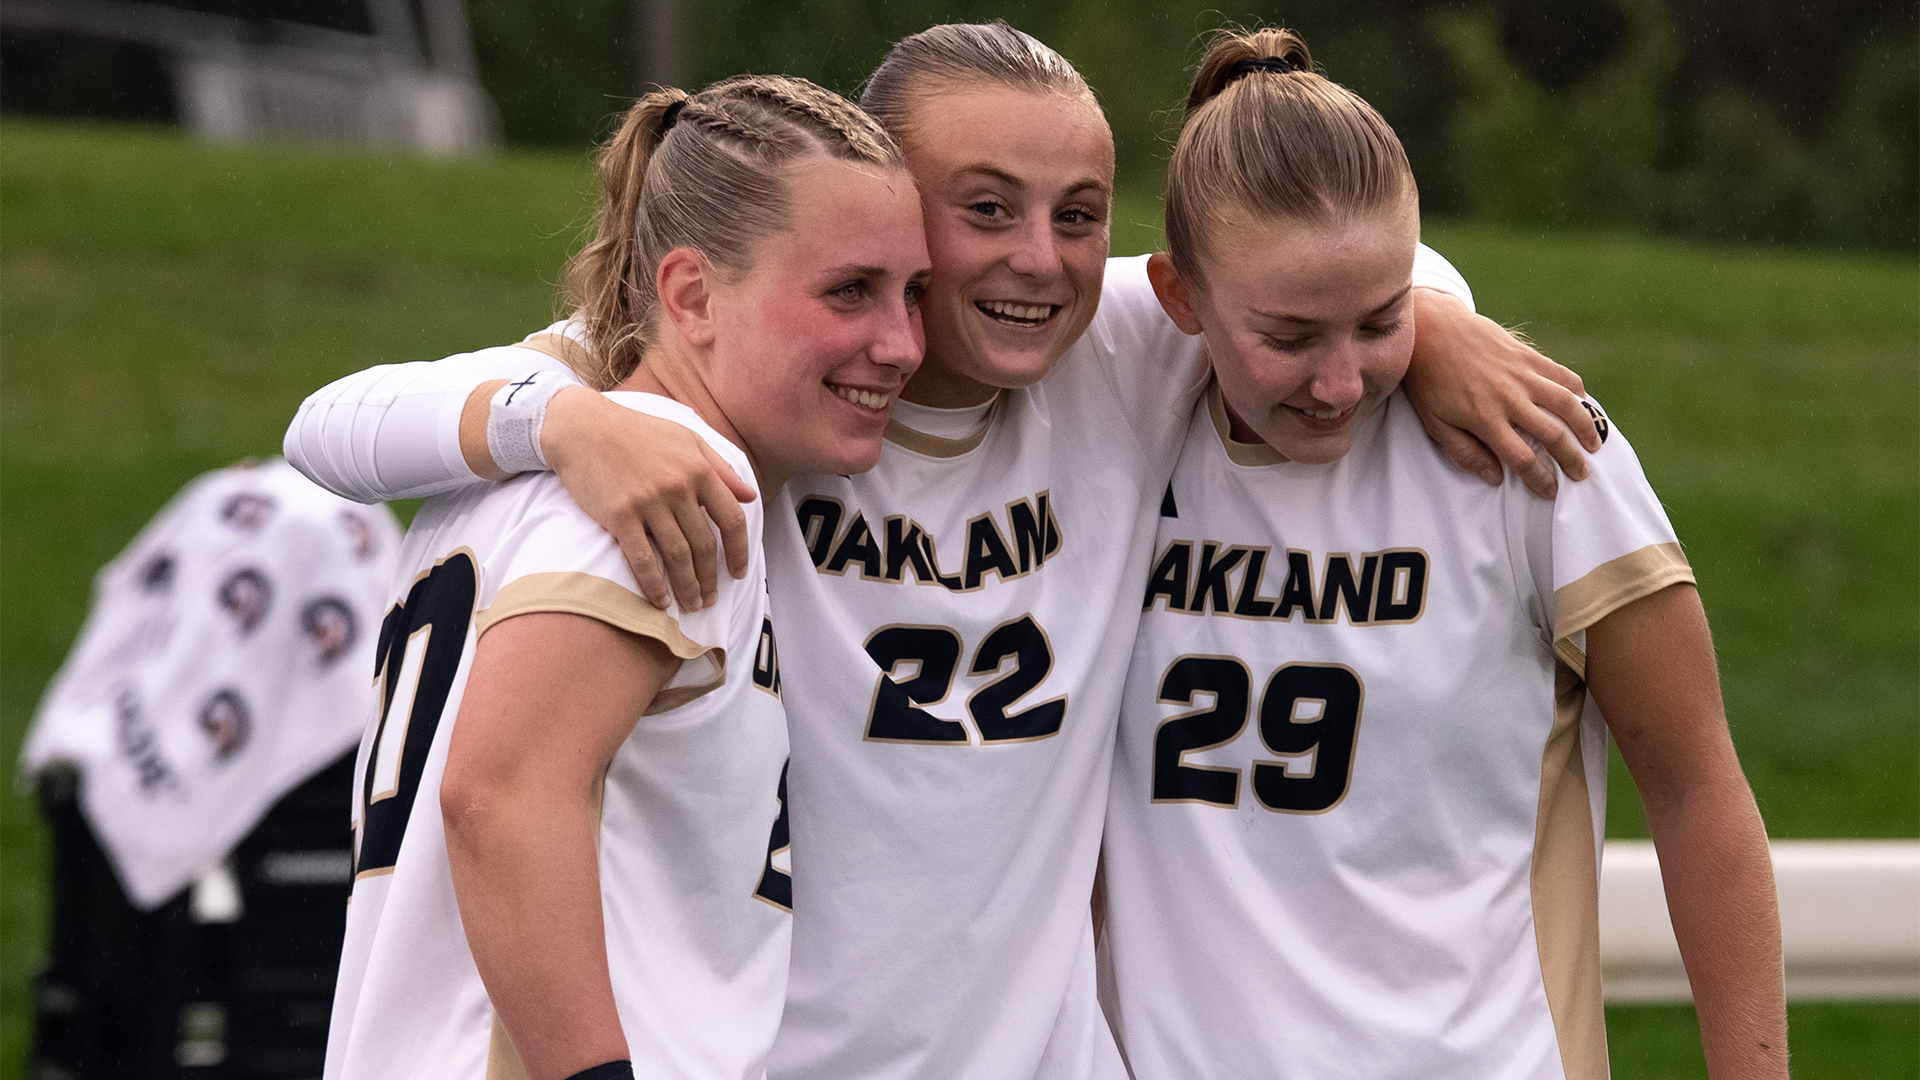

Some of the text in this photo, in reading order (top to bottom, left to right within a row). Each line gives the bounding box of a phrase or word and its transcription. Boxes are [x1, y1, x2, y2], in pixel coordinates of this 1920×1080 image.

[1143, 538, 1431, 627] AKLAND
[347, 545, 481, 905] 0
[862, 612, 1069, 746] 22
[1150, 653, 1366, 816] 29
